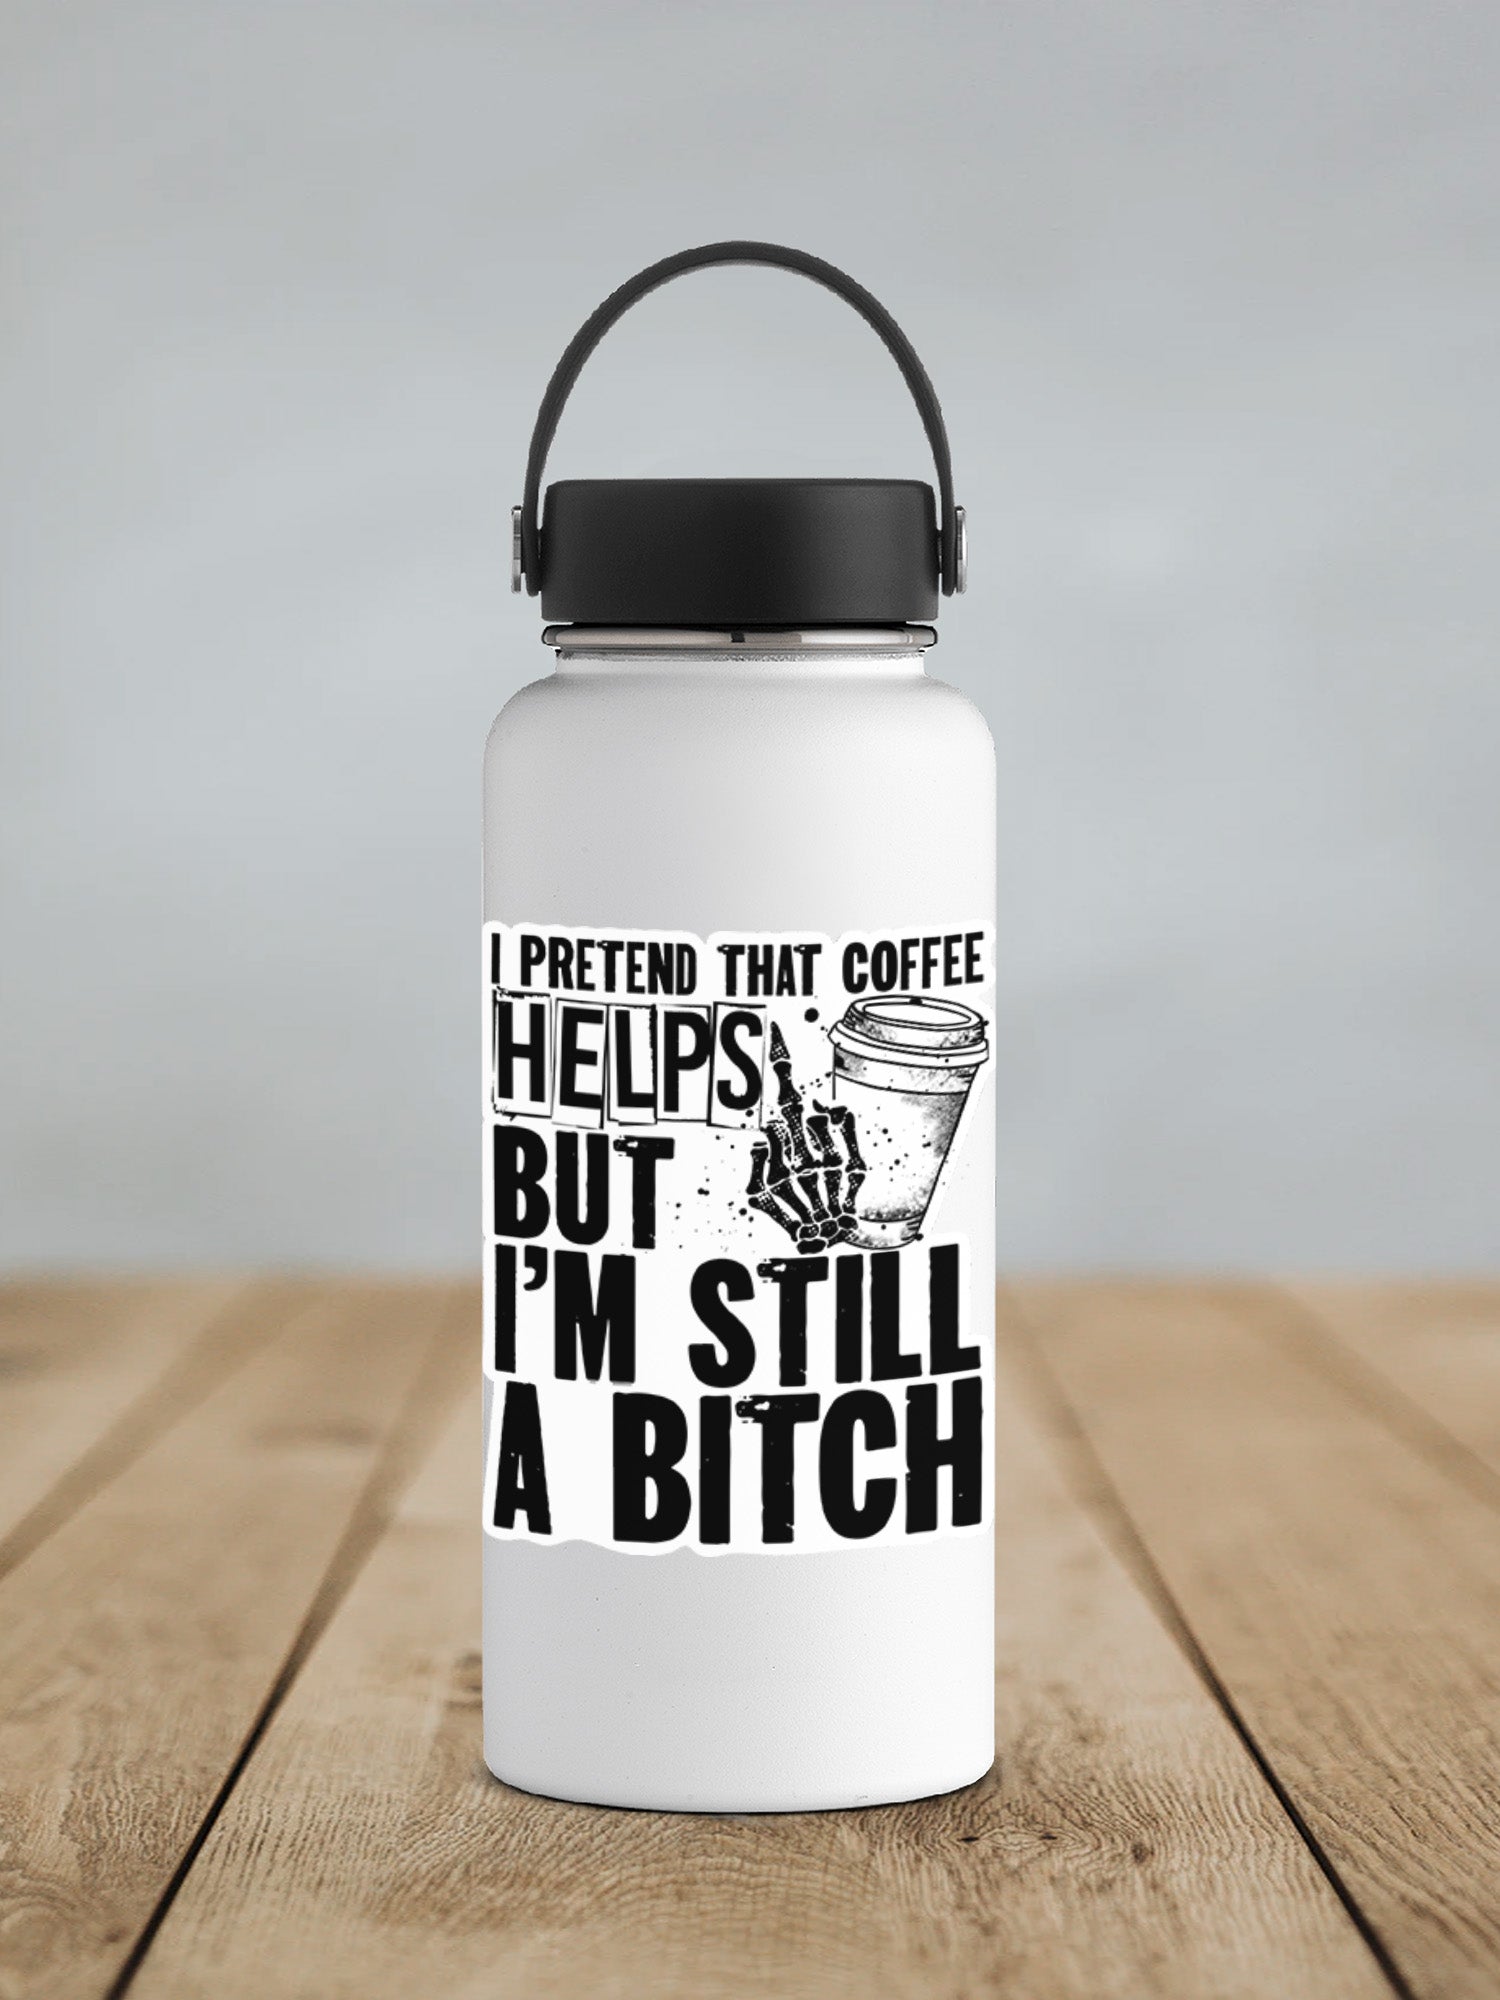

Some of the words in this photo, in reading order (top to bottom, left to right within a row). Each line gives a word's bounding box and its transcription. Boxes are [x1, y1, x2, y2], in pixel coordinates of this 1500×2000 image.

[491, 932, 501, 985] I
[520, 934, 697, 996] PRETEND
[717, 943, 822, 997] THAT
[842, 931, 984, 994] COFFEE
[496, 1000, 764, 1113] HELPS
[493, 1124, 675, 1250] BUT
[494, 1243, 636, 1384] I'M
[688, 1243, 981, 1389] STILL
[493, 1380, 552, 1536] A
[612, 1376, 983, 1545] BITCH
